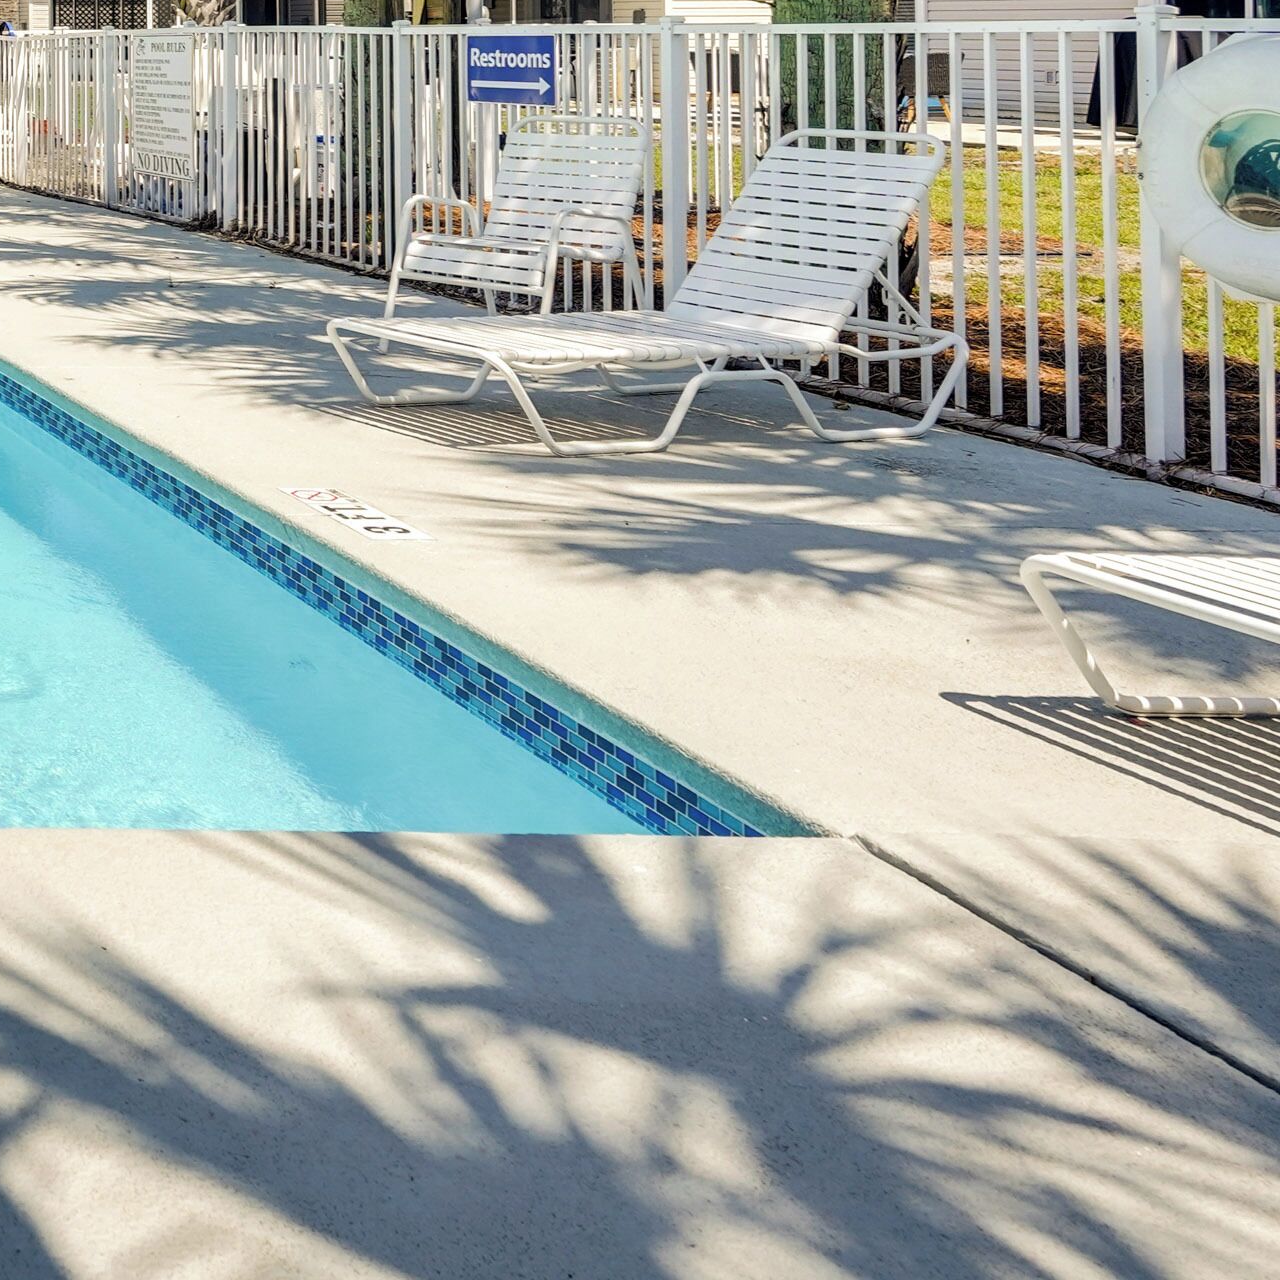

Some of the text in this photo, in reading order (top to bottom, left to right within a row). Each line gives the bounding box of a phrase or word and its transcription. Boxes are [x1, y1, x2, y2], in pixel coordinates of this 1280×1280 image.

[470, 47, 551, 69] Restrooms
[137, 152, 190, 177] NO DIVING
